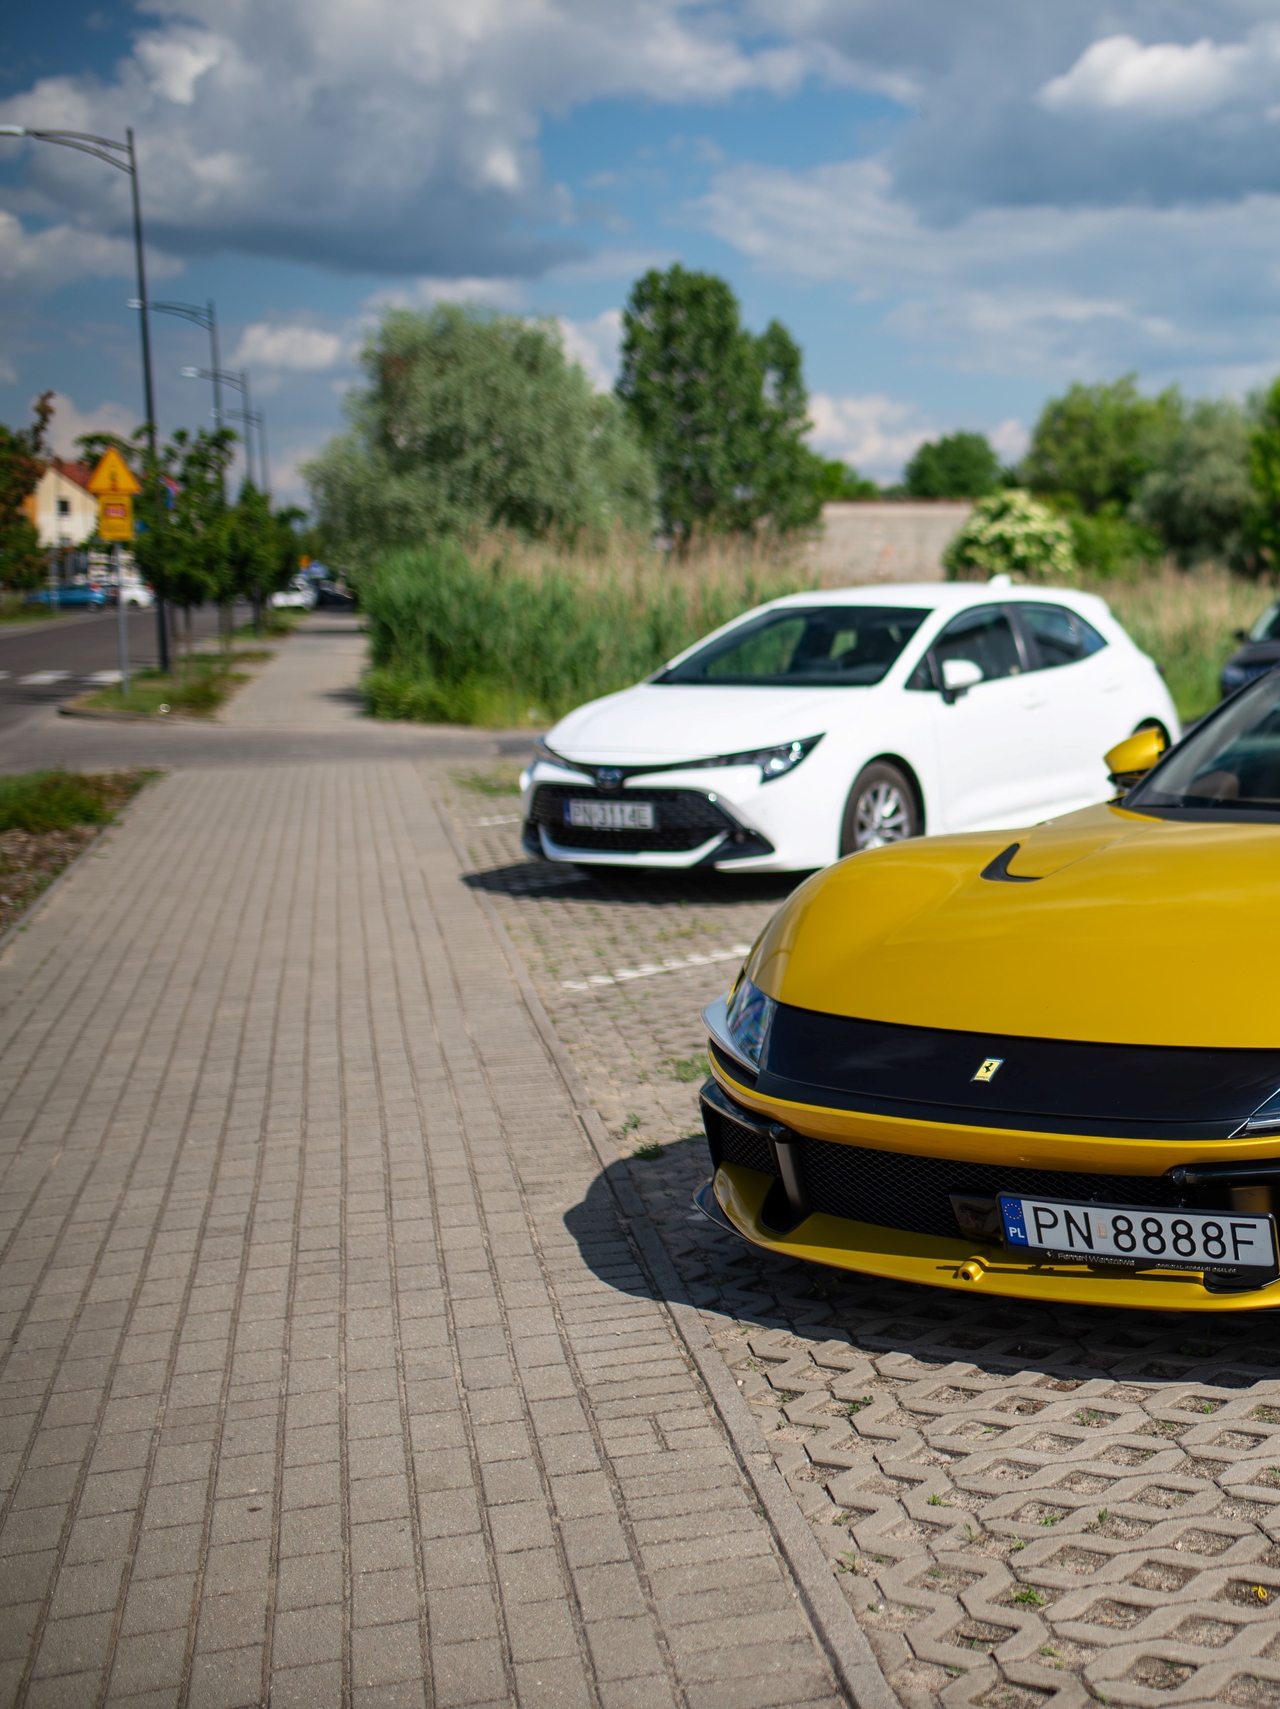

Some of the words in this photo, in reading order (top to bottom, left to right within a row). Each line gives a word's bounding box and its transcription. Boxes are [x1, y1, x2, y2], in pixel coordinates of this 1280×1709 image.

[1009, 1226, 1025, 1239] PL
[1032, 1205, 1094, 1250] PN
[1111, 1215, 1257, 1261] 8888F
[1057, 1252, 1088, 1263] Ferrari
[1088, 1255, 1135, 1266] Warszawa
